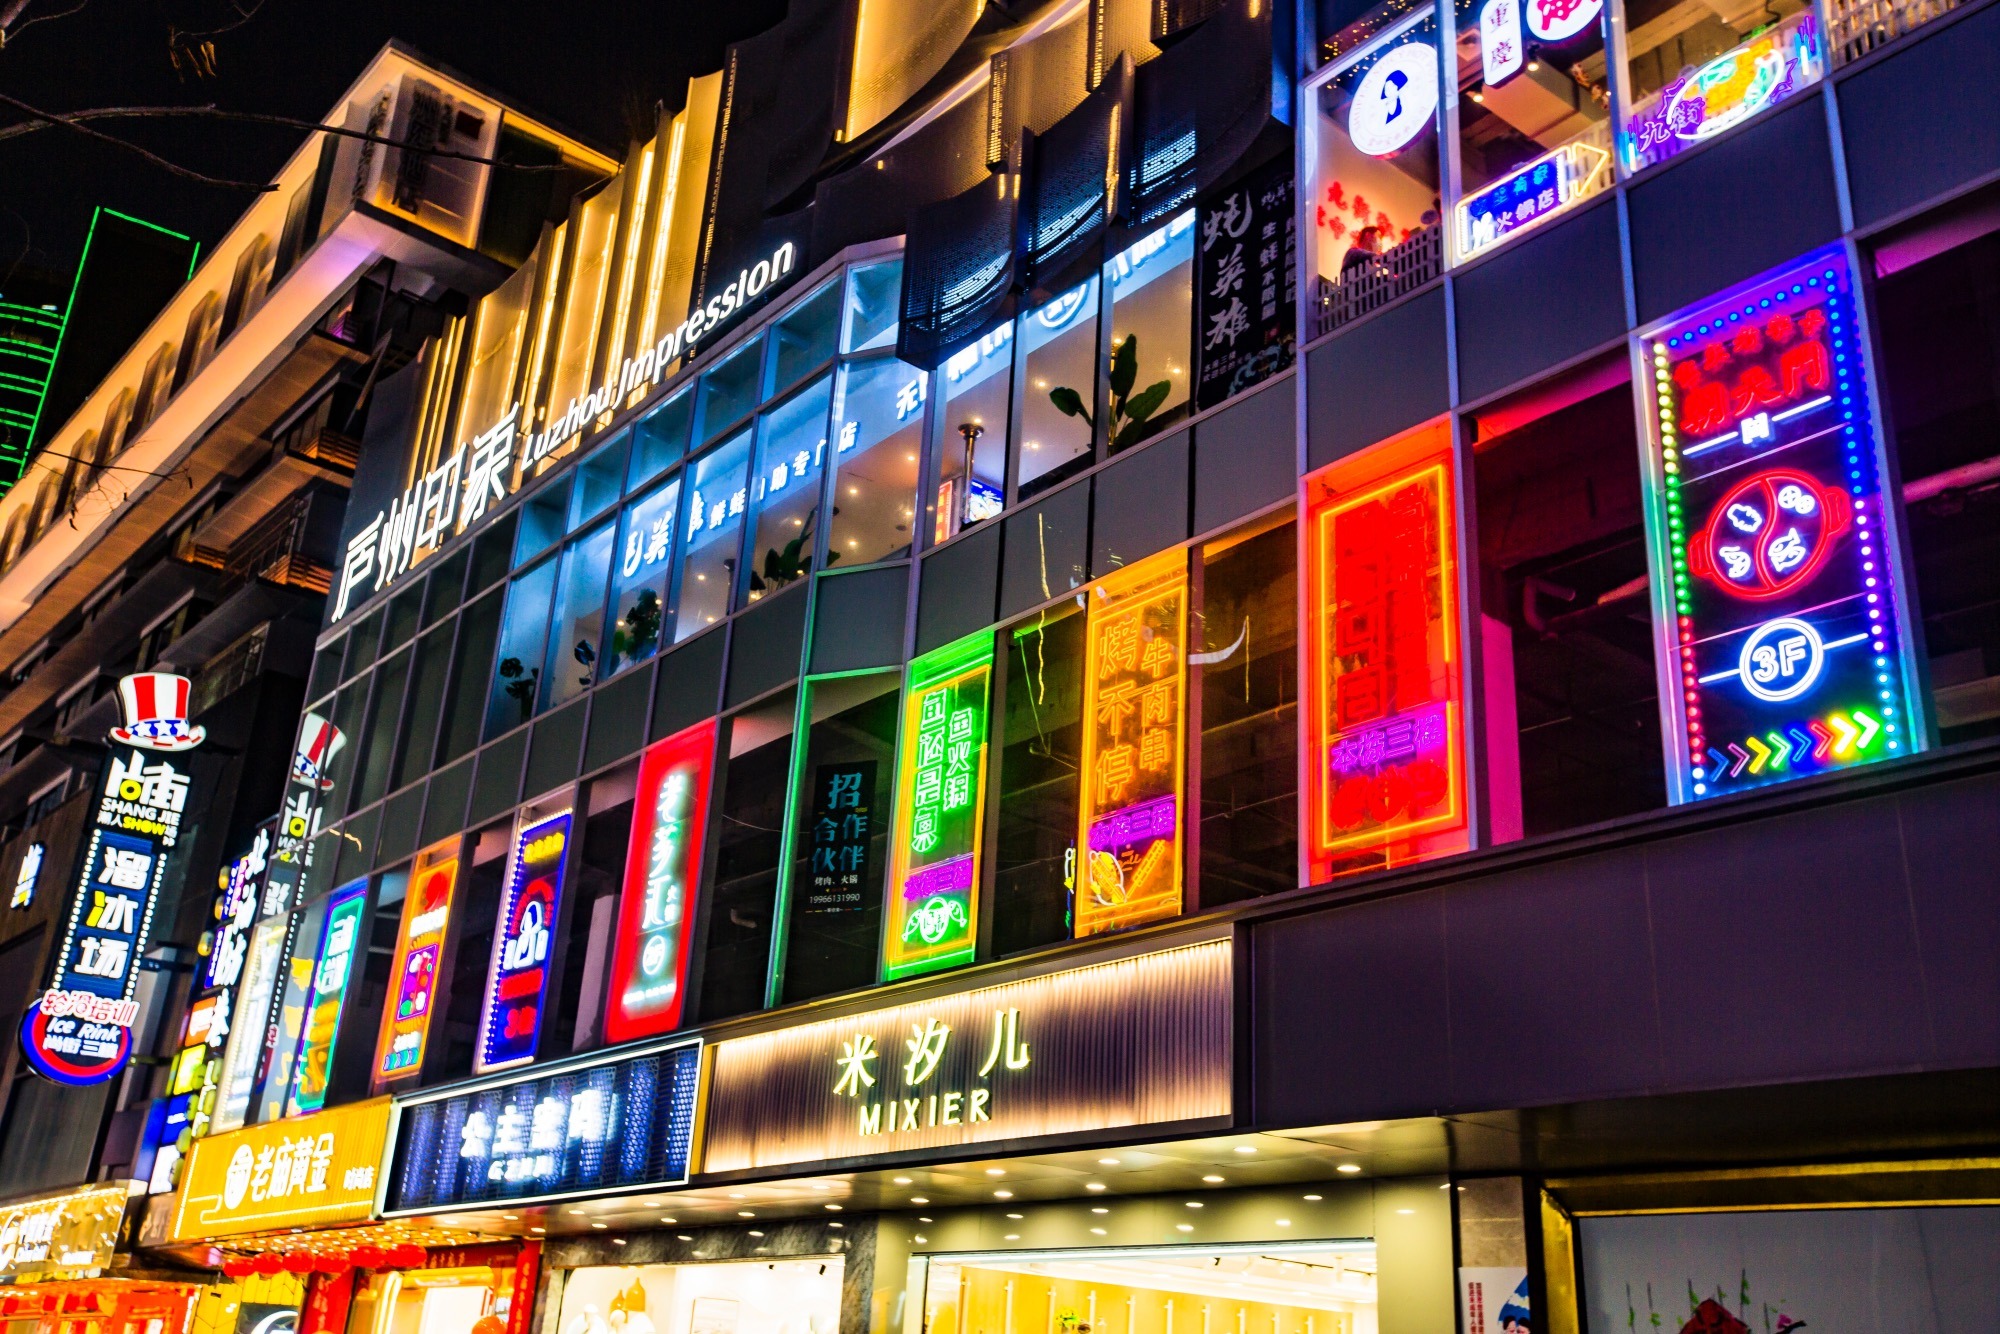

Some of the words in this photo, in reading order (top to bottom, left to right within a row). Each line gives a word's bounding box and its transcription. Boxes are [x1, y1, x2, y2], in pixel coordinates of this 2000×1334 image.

[520, 380, 613, 473] Luzhou
[612, 241, 796, 409] Impression
[331, 403, 520, 623] 庐州印象
[1751, 634, 1807, 684] 3F
[1096, 617, 1138, 804] 烤不停
[1139, 637, 1172, 771] 牛肉串
[943, 707, 972, 811] 鱼火锅
[101, 797, 157, 820] SHANG
[157, 810, 181, 826] JIE
[828, 772, 862, 809] 招
[814, 814, 868, 842] 合作
[812, 845, 864, 874] 伙伴
[73, 846, 152, 980] 溜冰场
[809, 893, 861, 904] 19966131990
[41, 990, 139, 1026] 轮滑培训
[47, 1017, 76, 1034] Ice
[77, 1023, 122, 1042] Rink
[833, 1007, 1031, 1097] 米汐儿
[858, 1088, 991, 1136] MIXIER
